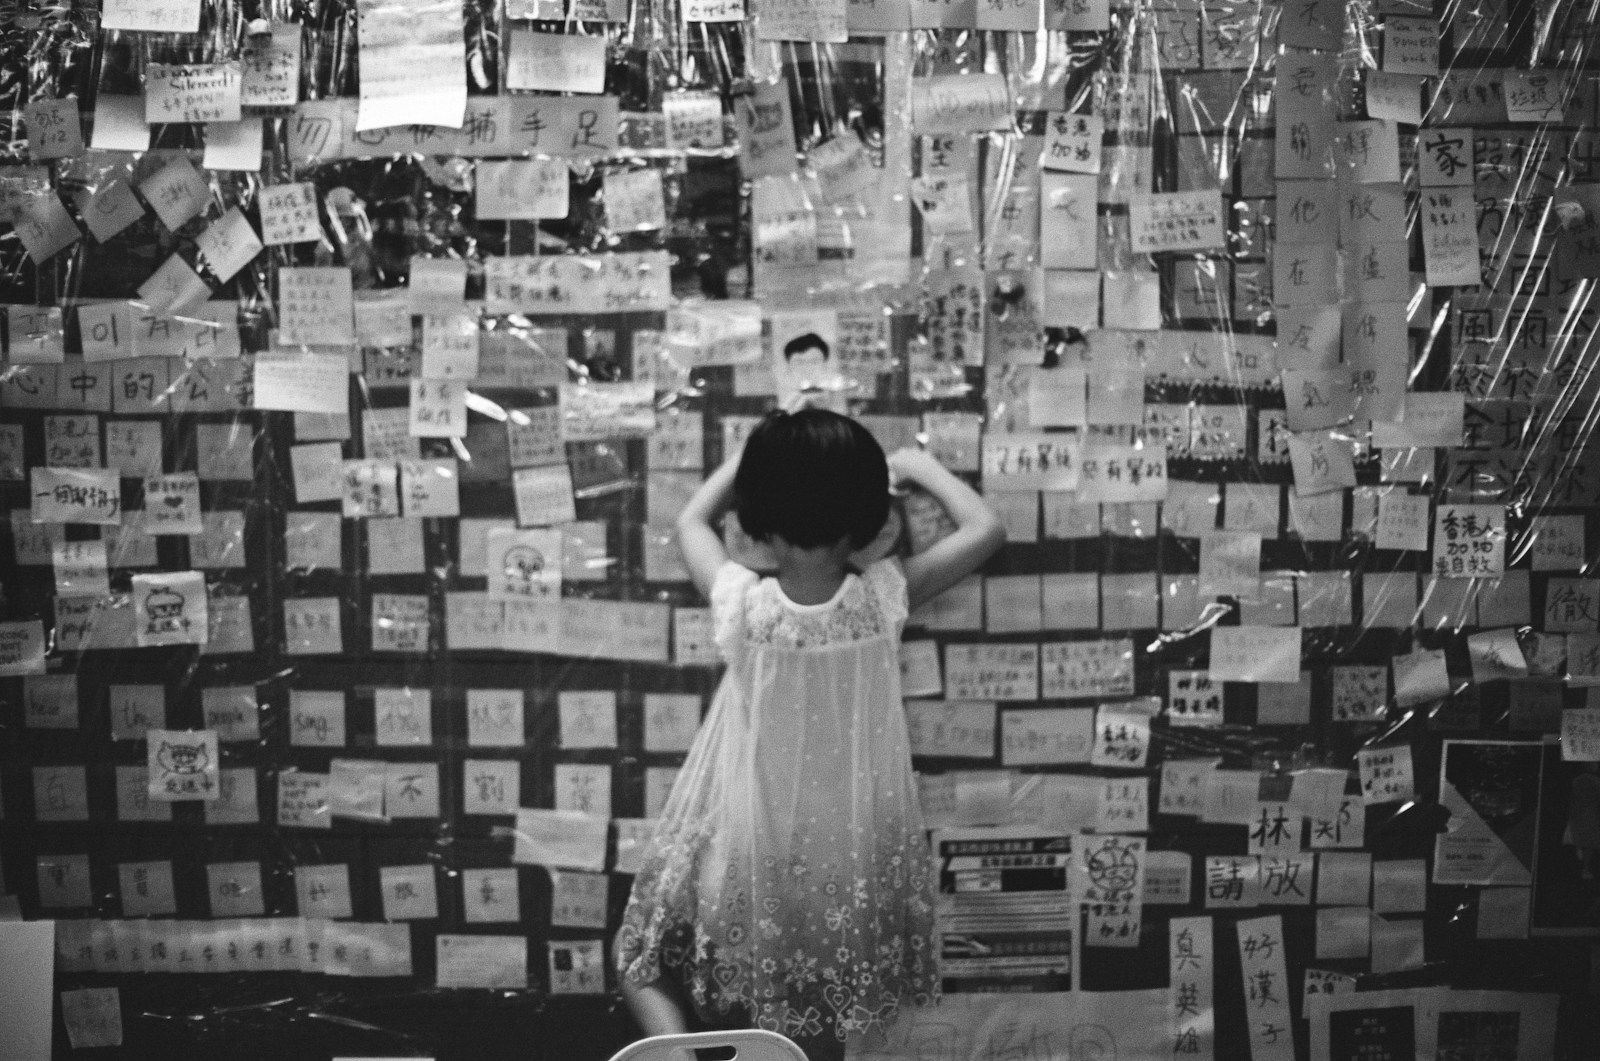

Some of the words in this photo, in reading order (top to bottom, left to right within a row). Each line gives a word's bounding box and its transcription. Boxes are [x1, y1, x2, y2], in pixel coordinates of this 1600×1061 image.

[1425, 133, 1468, 178] 家
[1441, 508, 1493, 540] 香港人
[1446, 540, 1494, 556] 加油
[1208, 857, 1306, 901] 請放
[1172, 927, 1202, 1054] 真英雄
[1243, 933, 1286, 1046] 好漢子
